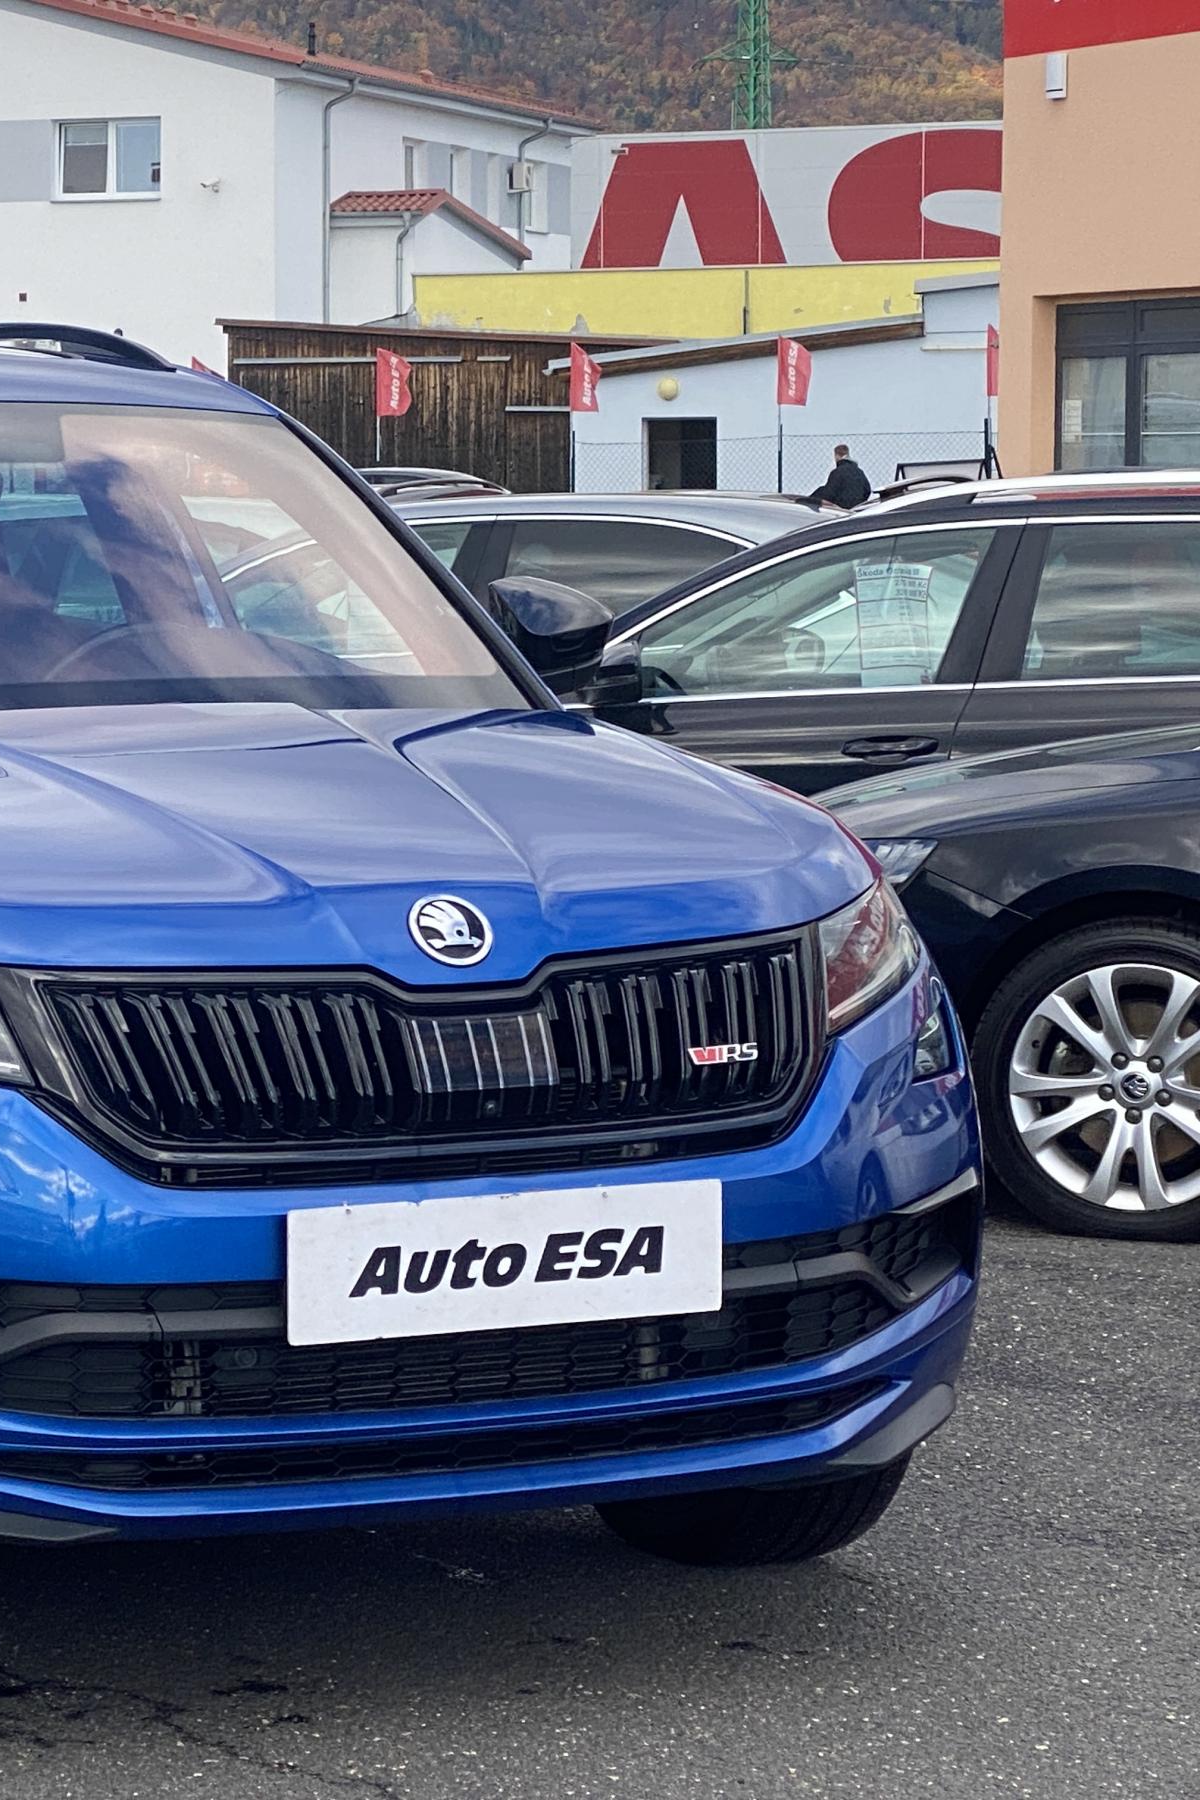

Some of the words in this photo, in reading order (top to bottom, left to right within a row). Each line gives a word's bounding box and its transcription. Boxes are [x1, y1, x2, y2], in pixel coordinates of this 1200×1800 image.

[390, 378, 400, 410] Auto
[787, 366, 796, 399] Auto
[348, 1238, 528, 1299] Auto
[534, 1226, 665, 1283] ESA
